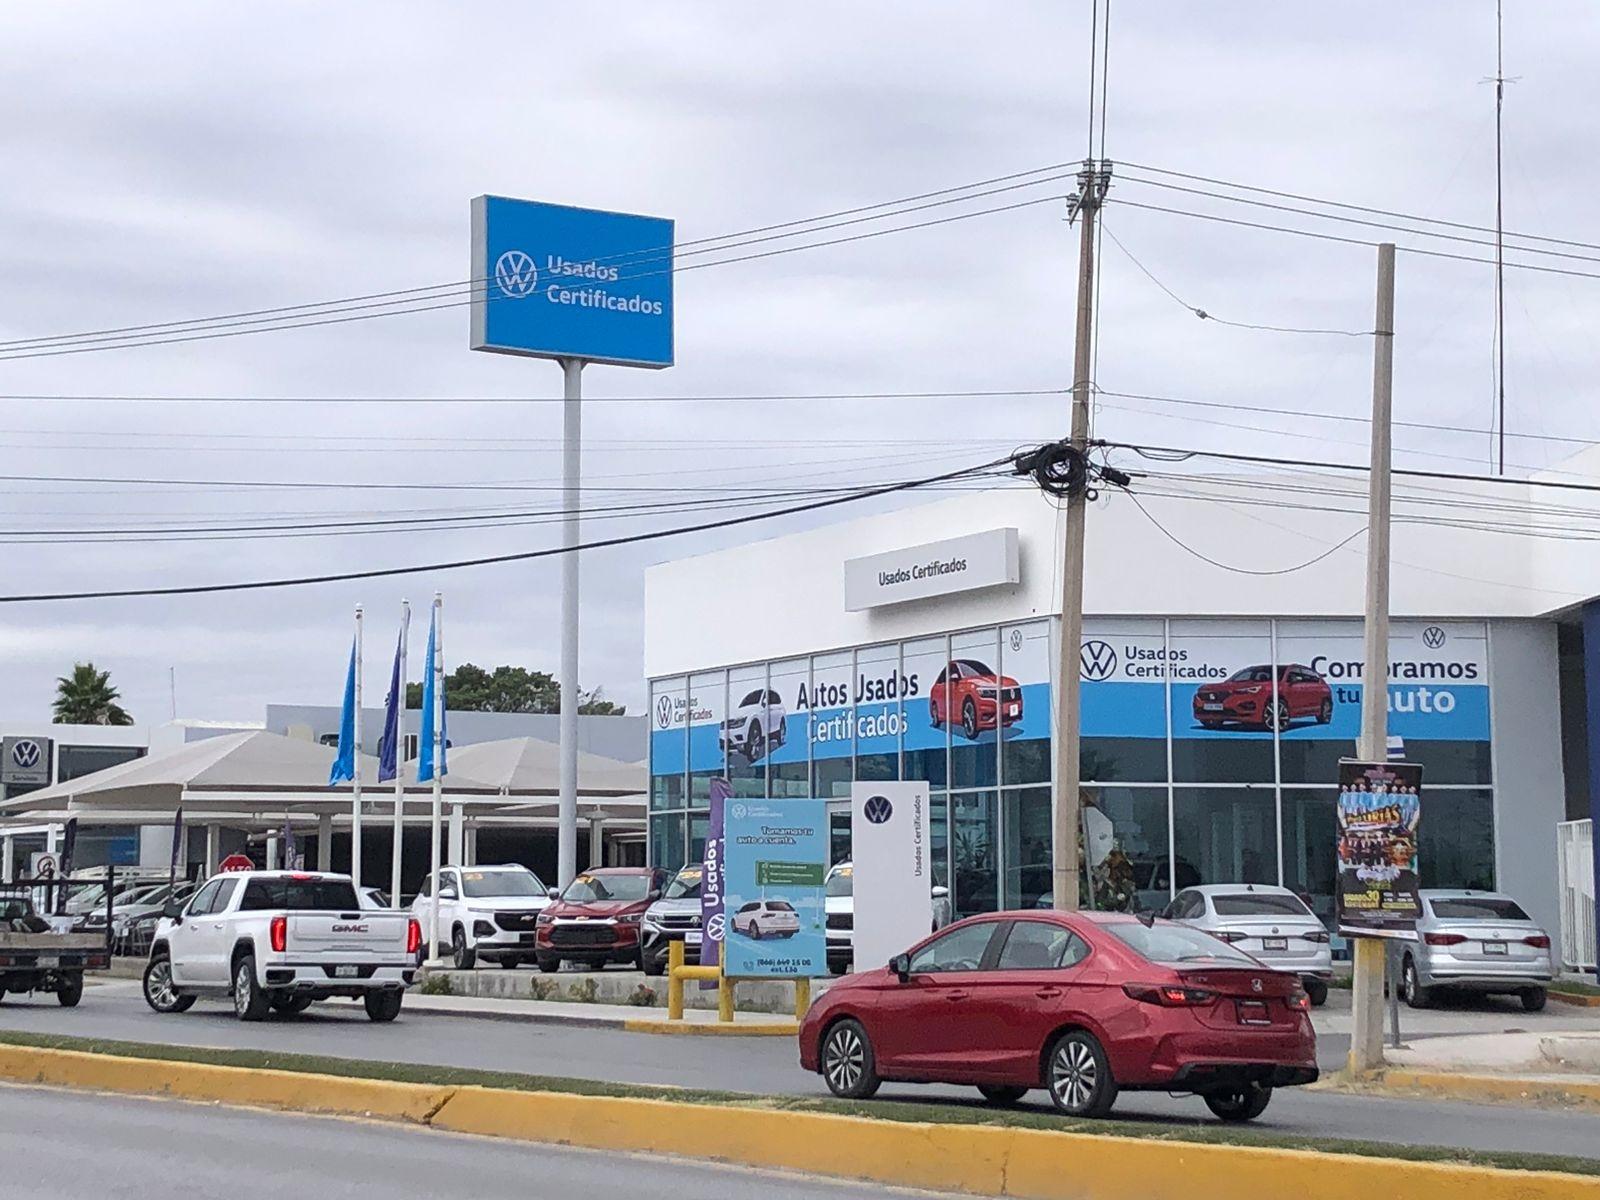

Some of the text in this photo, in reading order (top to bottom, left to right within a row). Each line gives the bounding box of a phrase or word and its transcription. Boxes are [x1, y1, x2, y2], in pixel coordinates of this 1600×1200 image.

[547, 255, 619, 281] Usados
[547, 284, 663, 315] Certificados
[878, 557, 967, 586] Usados Certificados
[1125, 646, 1188, 661] Usados
[1311, 656, 1479, 679] Comramos
[1336, 687, 1456, 714] tu uto
[913, 794, 922, 877] Usados Certificados
[704, 839, 719, 907] Usados
[332, 924, 368, 932] GMC
